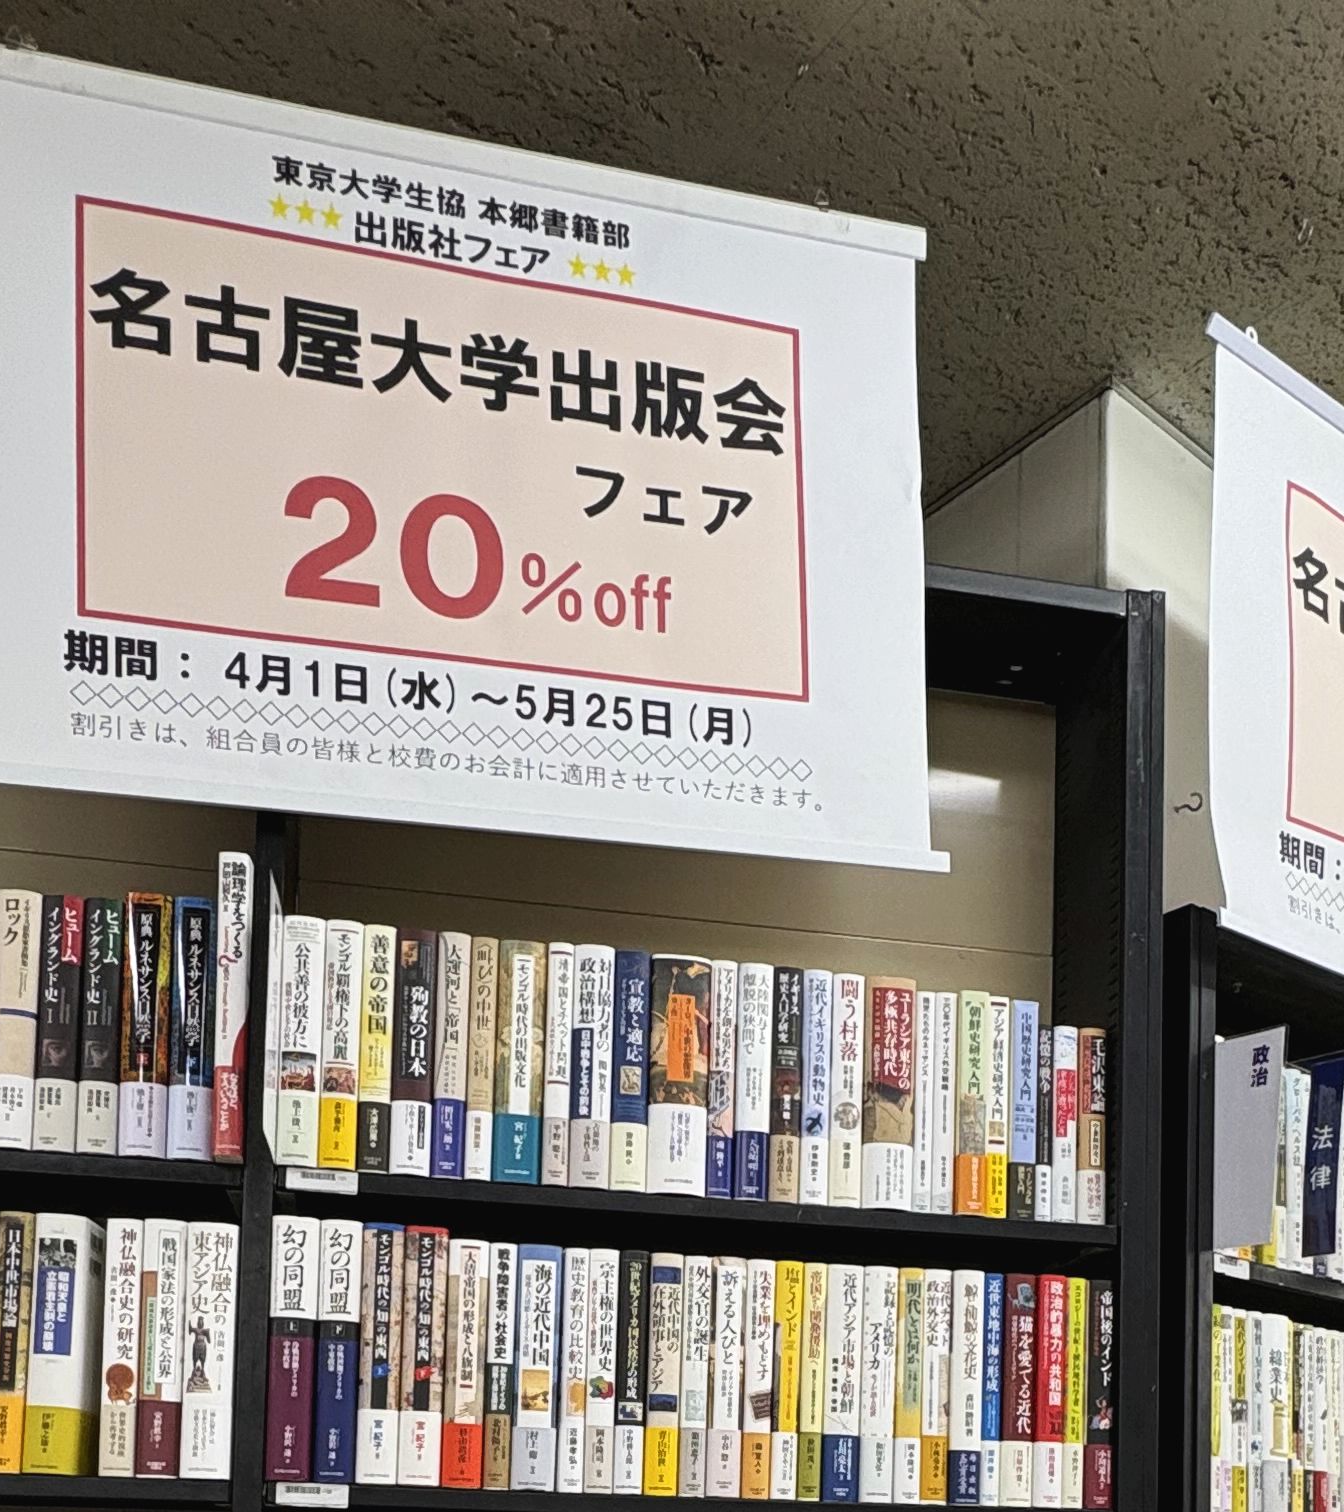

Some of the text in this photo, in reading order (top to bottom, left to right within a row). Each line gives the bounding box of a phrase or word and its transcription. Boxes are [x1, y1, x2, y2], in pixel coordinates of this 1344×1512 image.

[272, 155, 630, 252] 東京大学生協 本郷書籍部
[355, 211, 551, 274] 出版社フェア
[90, 267, 787, 456] 名古屋大学出版会
[575, 465, 753, 536] フェア
[283, 474, 672, 635] 20%off
[70, 710, 825, 814] 割引きは、組合員の皆様と校費のお会計に適用させていただきます。
[4, 897, 19, 946] ロック
[64, 907, 77, 964] ヒューム
[105, 909, 118, 966] ヒューム
[367, 934, 389, 1035] 善意の帝国
[578, 957, 595, 1024] 政治構想
[839, 978, 858, 1062] 闘う村落
[408, 985, 429, 1077] 殉教の日本
[1250, 1044, 1270, 1088] 政治
[1310, 1126, 1334, 1190] 法律
[190, 1232, 211, 1314] 東アジア史
[210, 1232, 233, 1324] 神仏融合の
[280, 1224, 307, 1311] 幻の同盟
[327, 1227, 354, 1314] 幻の同盟
[783, 1266, 800, 1337] 塩とインド
[532, 1263, 553, 1366] 海の近代中国
[693, 1265, 711, 1362] 外交官の誕生
[718, 1270, 740, 1365] 訴える人びと
[840, 1273, 857, 1413] 近代アジア市場と朝鮮
[1015, 1316, 1032, 1434] 猫を愛でる近代
